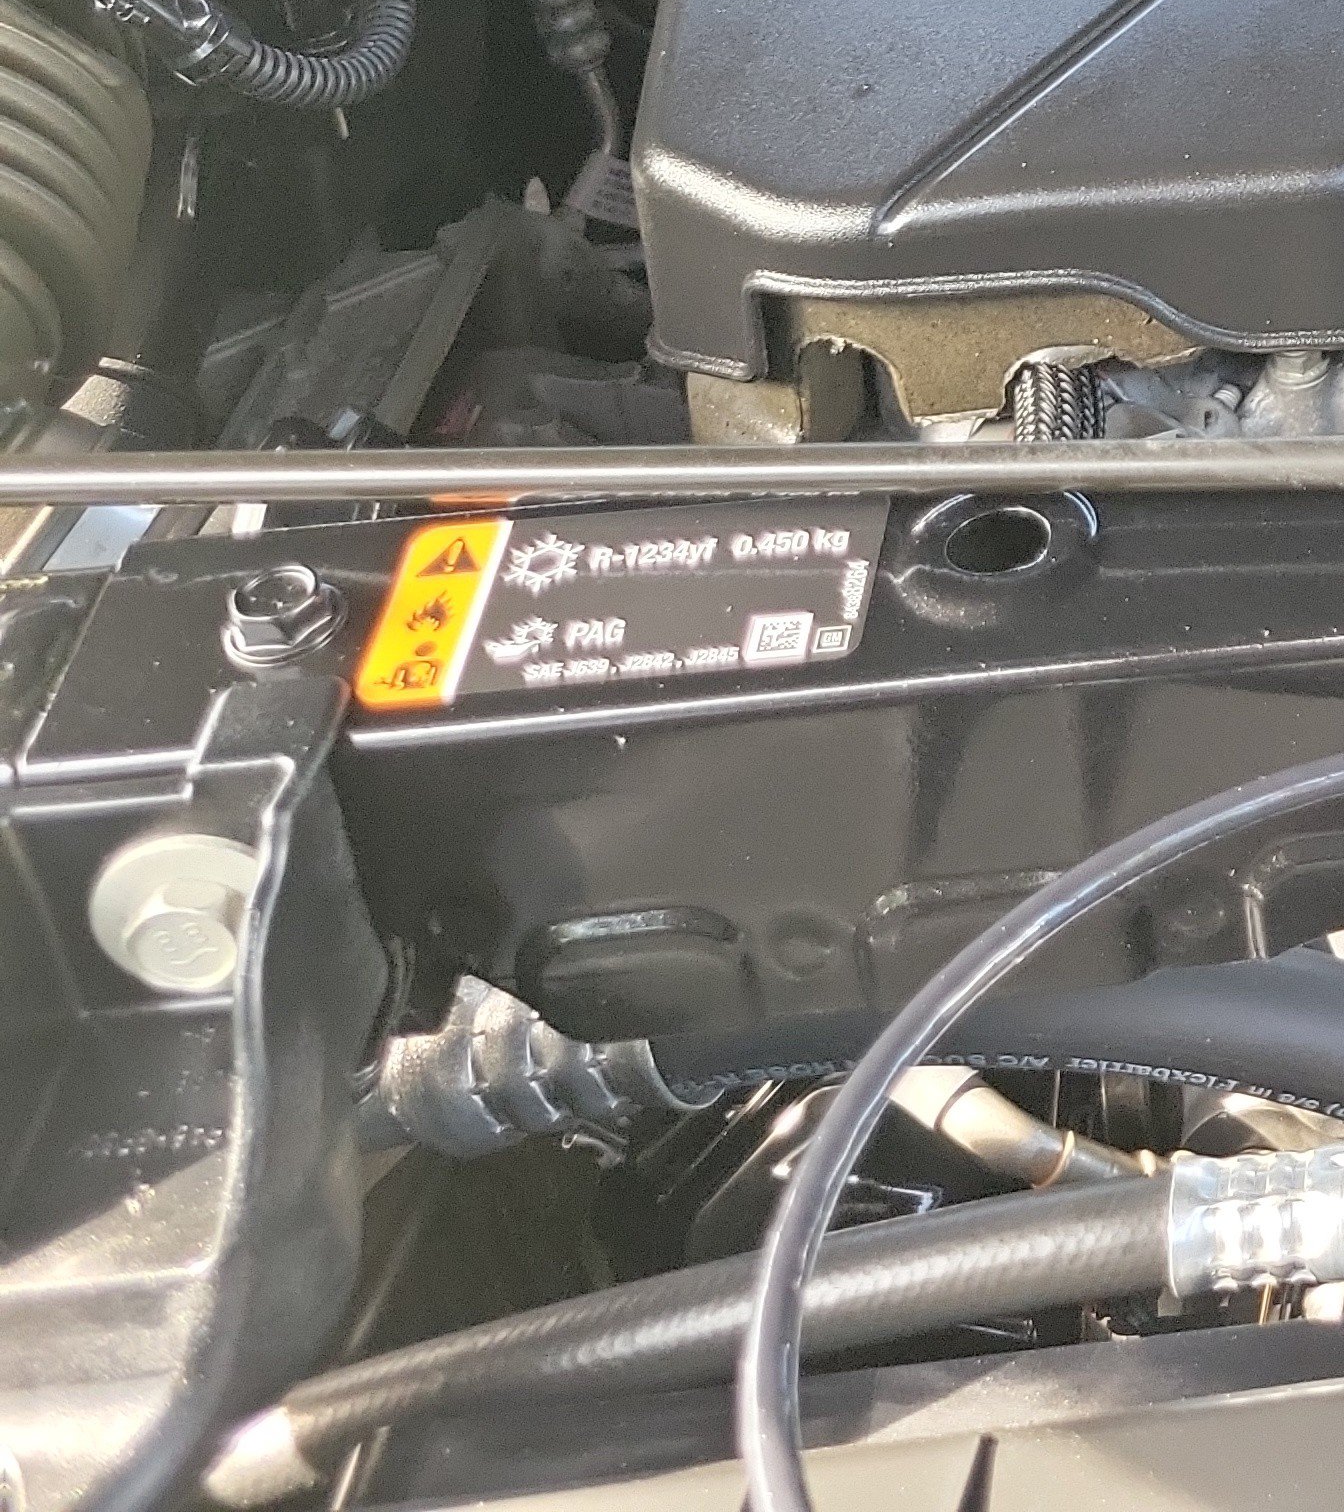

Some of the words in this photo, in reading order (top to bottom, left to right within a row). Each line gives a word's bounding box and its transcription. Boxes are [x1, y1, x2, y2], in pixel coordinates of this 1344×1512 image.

[588, 536, 718, 570] R-1234yf
[732, 531, 809, 559] 0.450
[812, 529, 850, 553] kg
[563, 618, 627, 650] PAG
[523, 661, 563, 683] SAE
